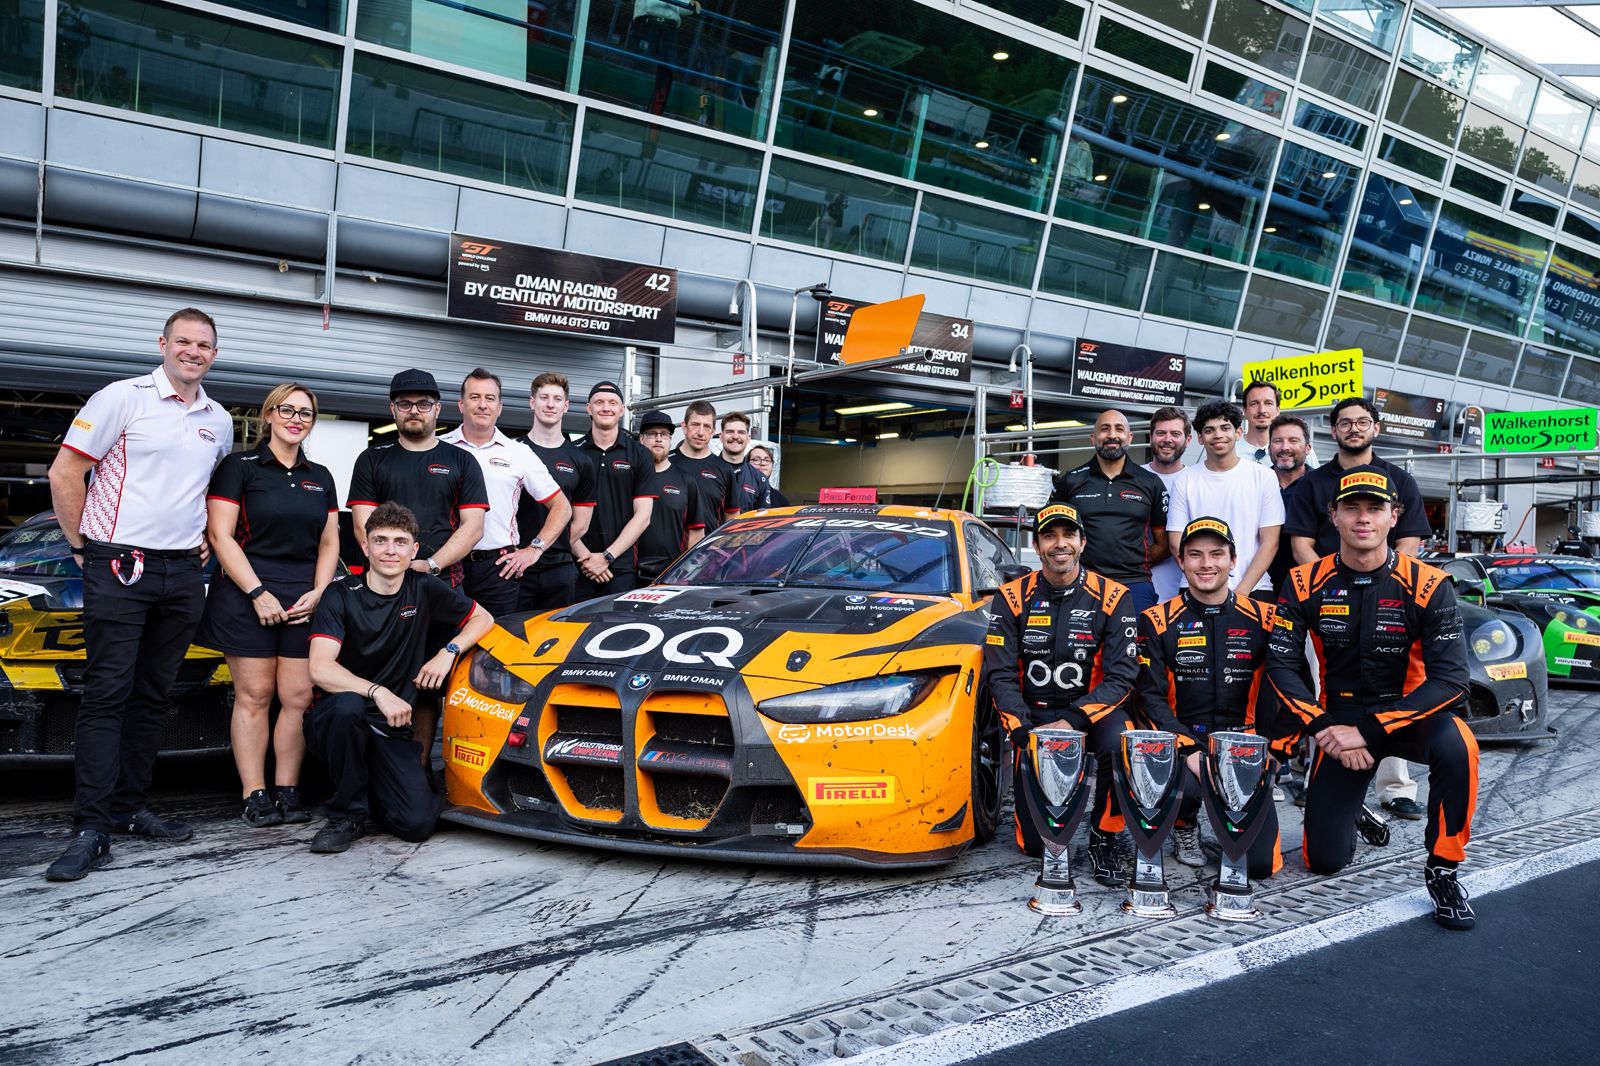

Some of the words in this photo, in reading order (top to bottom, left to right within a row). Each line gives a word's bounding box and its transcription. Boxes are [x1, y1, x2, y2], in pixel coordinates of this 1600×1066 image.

[460, 242, 502, 255] GT
[515, 274, 561, 293] OMAN
[563, 280, 618, 301] RACING
[644, 273, 671, 292] 42
[464, 282, 488, 298] BY
[490, 284, 562, 308] CENTURY
[563, 296, 662, 320] MOTORSPORT
[524, 311, 551, 324] BMW
[551, 314, 568, 326] M4
[568, 316, 589, 329] GT3
[590, 318, 610, 331] EVO
[951, 323, 969, 339] 34
[734, 358, 743, 370] 15
[945, 367, 959, 376] EVO
[1169, 358, 1183, 371] 35
[1250, 358, 1355, 383] Walkenhorst
[1077, 369, 1133, 386] WALKENHORST
[1133, 377, 1182, 392] MOTORSPORT
[1012, 394, 1022, 404] 14
[1081, 386, 1100, 395] ASTON
[1436, 402, 1442, 413] 5
[1492, 415, 1590, 429] Walkenhorst
[1490, 431, 1589, 450] MotorSport
[1343, 474, 1384, 487] PIRELLI
[792, 518, 949, 538] WORLD
[1295, 570, 1306, 592] HRX
[1420, 574, 1437, 600] HRX
[624, 592, 665, 601] ROWE
[1005, 588, 1020, 609] HRX
[1106, 587, 1120, 608] HRX
[1070, 609, 1096, 618] GT
[1148, 609, 1163, 627] HRX
[1265, 605, 1274, 625] HRX
[584, 623, 744, 668] OQ
[1027, 660, 1084, 689] OQ
[1491, 665, 1525, 676] PIRELLI
[662, 674, 690, 682] BMW
[690, 676, 724, 686] OMAN
[463, 695, 515, 721] MotorDesk
[816, 724, 916, 737] MotorDesk
[454, 745, 486, 766] PIRELLI
[816, 782, 888, 799] PIRELLI
